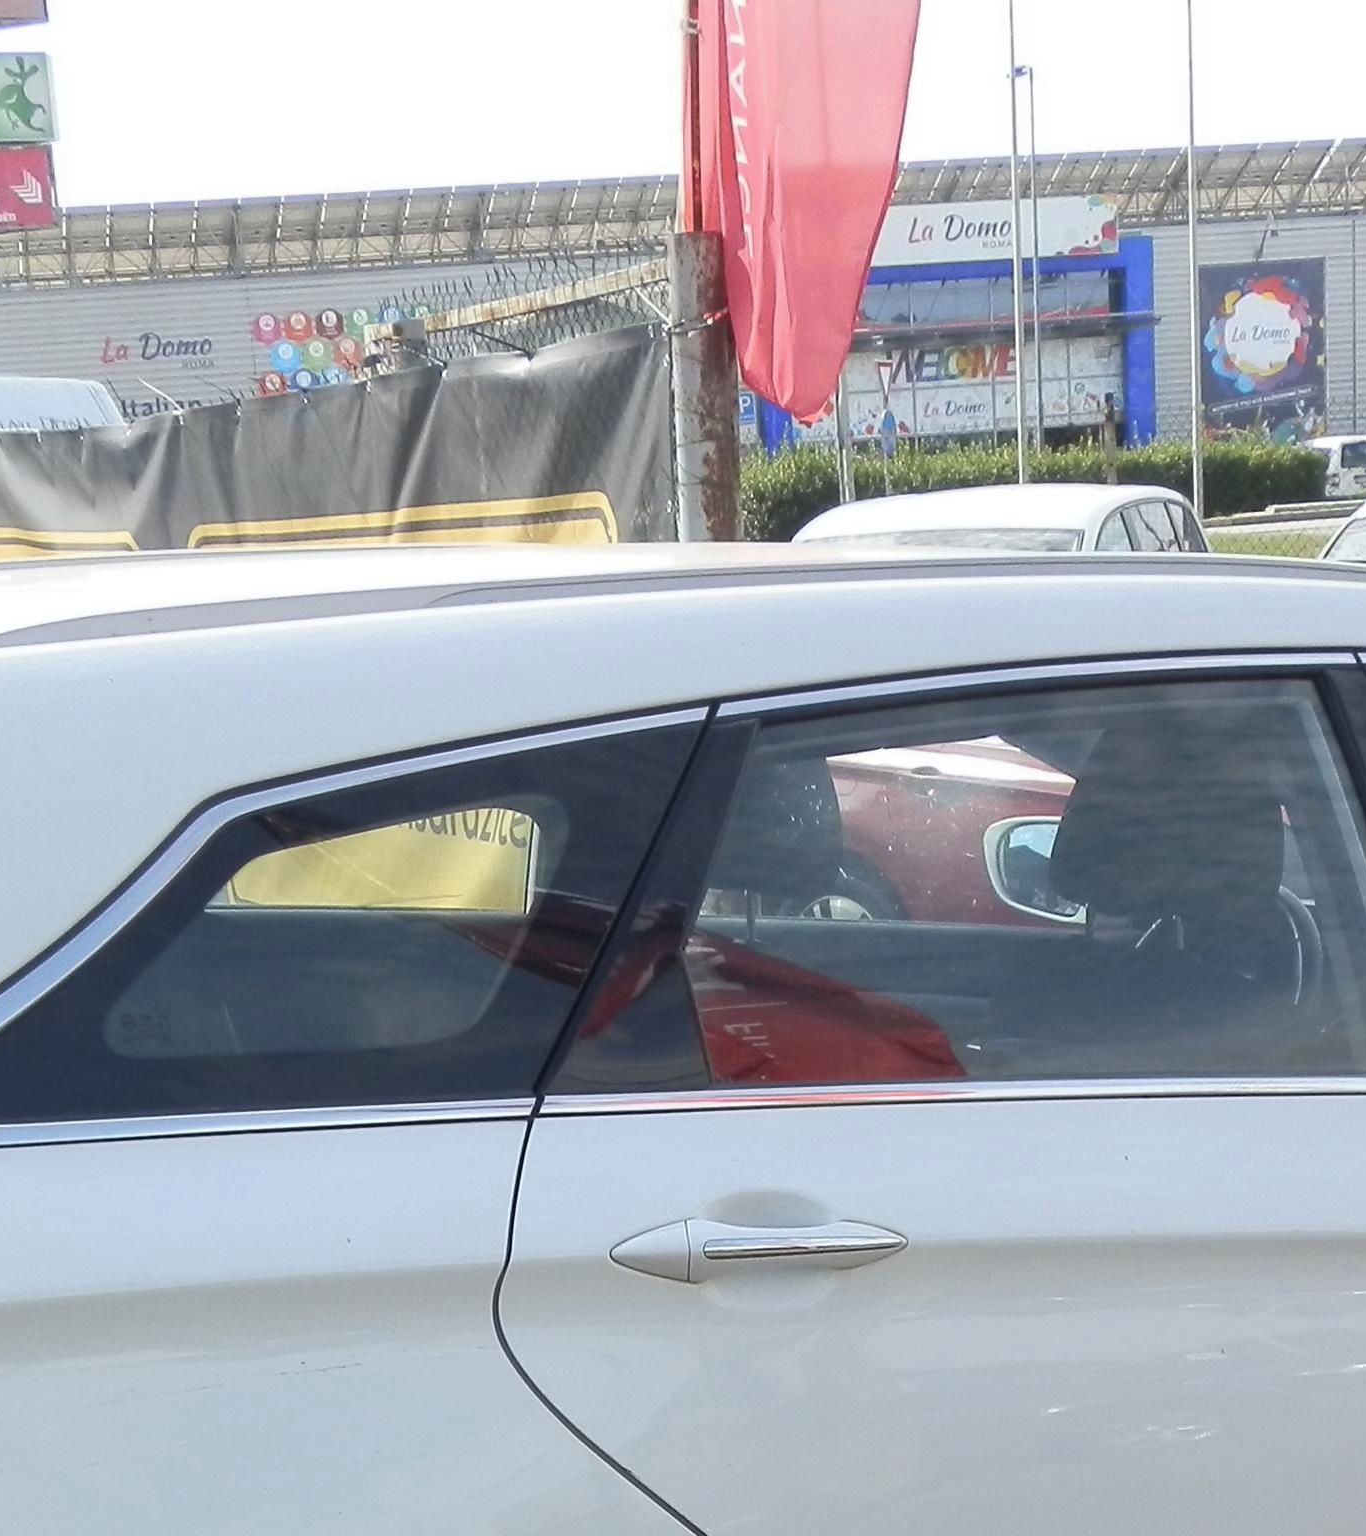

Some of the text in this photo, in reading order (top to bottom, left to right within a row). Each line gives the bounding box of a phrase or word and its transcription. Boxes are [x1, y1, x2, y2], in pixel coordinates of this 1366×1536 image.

[908, 213, 1012, 244] La Domo
[982, 240, 1013, 249] ROMA
[1231, 325, 1291, 342] La Domo
[101, 331, 213, 364] La Domo
[887, 344, 1017, 384] WELCOME
[739, 395, 751, 413] P
[923, 400, 985, 418] La Domo
